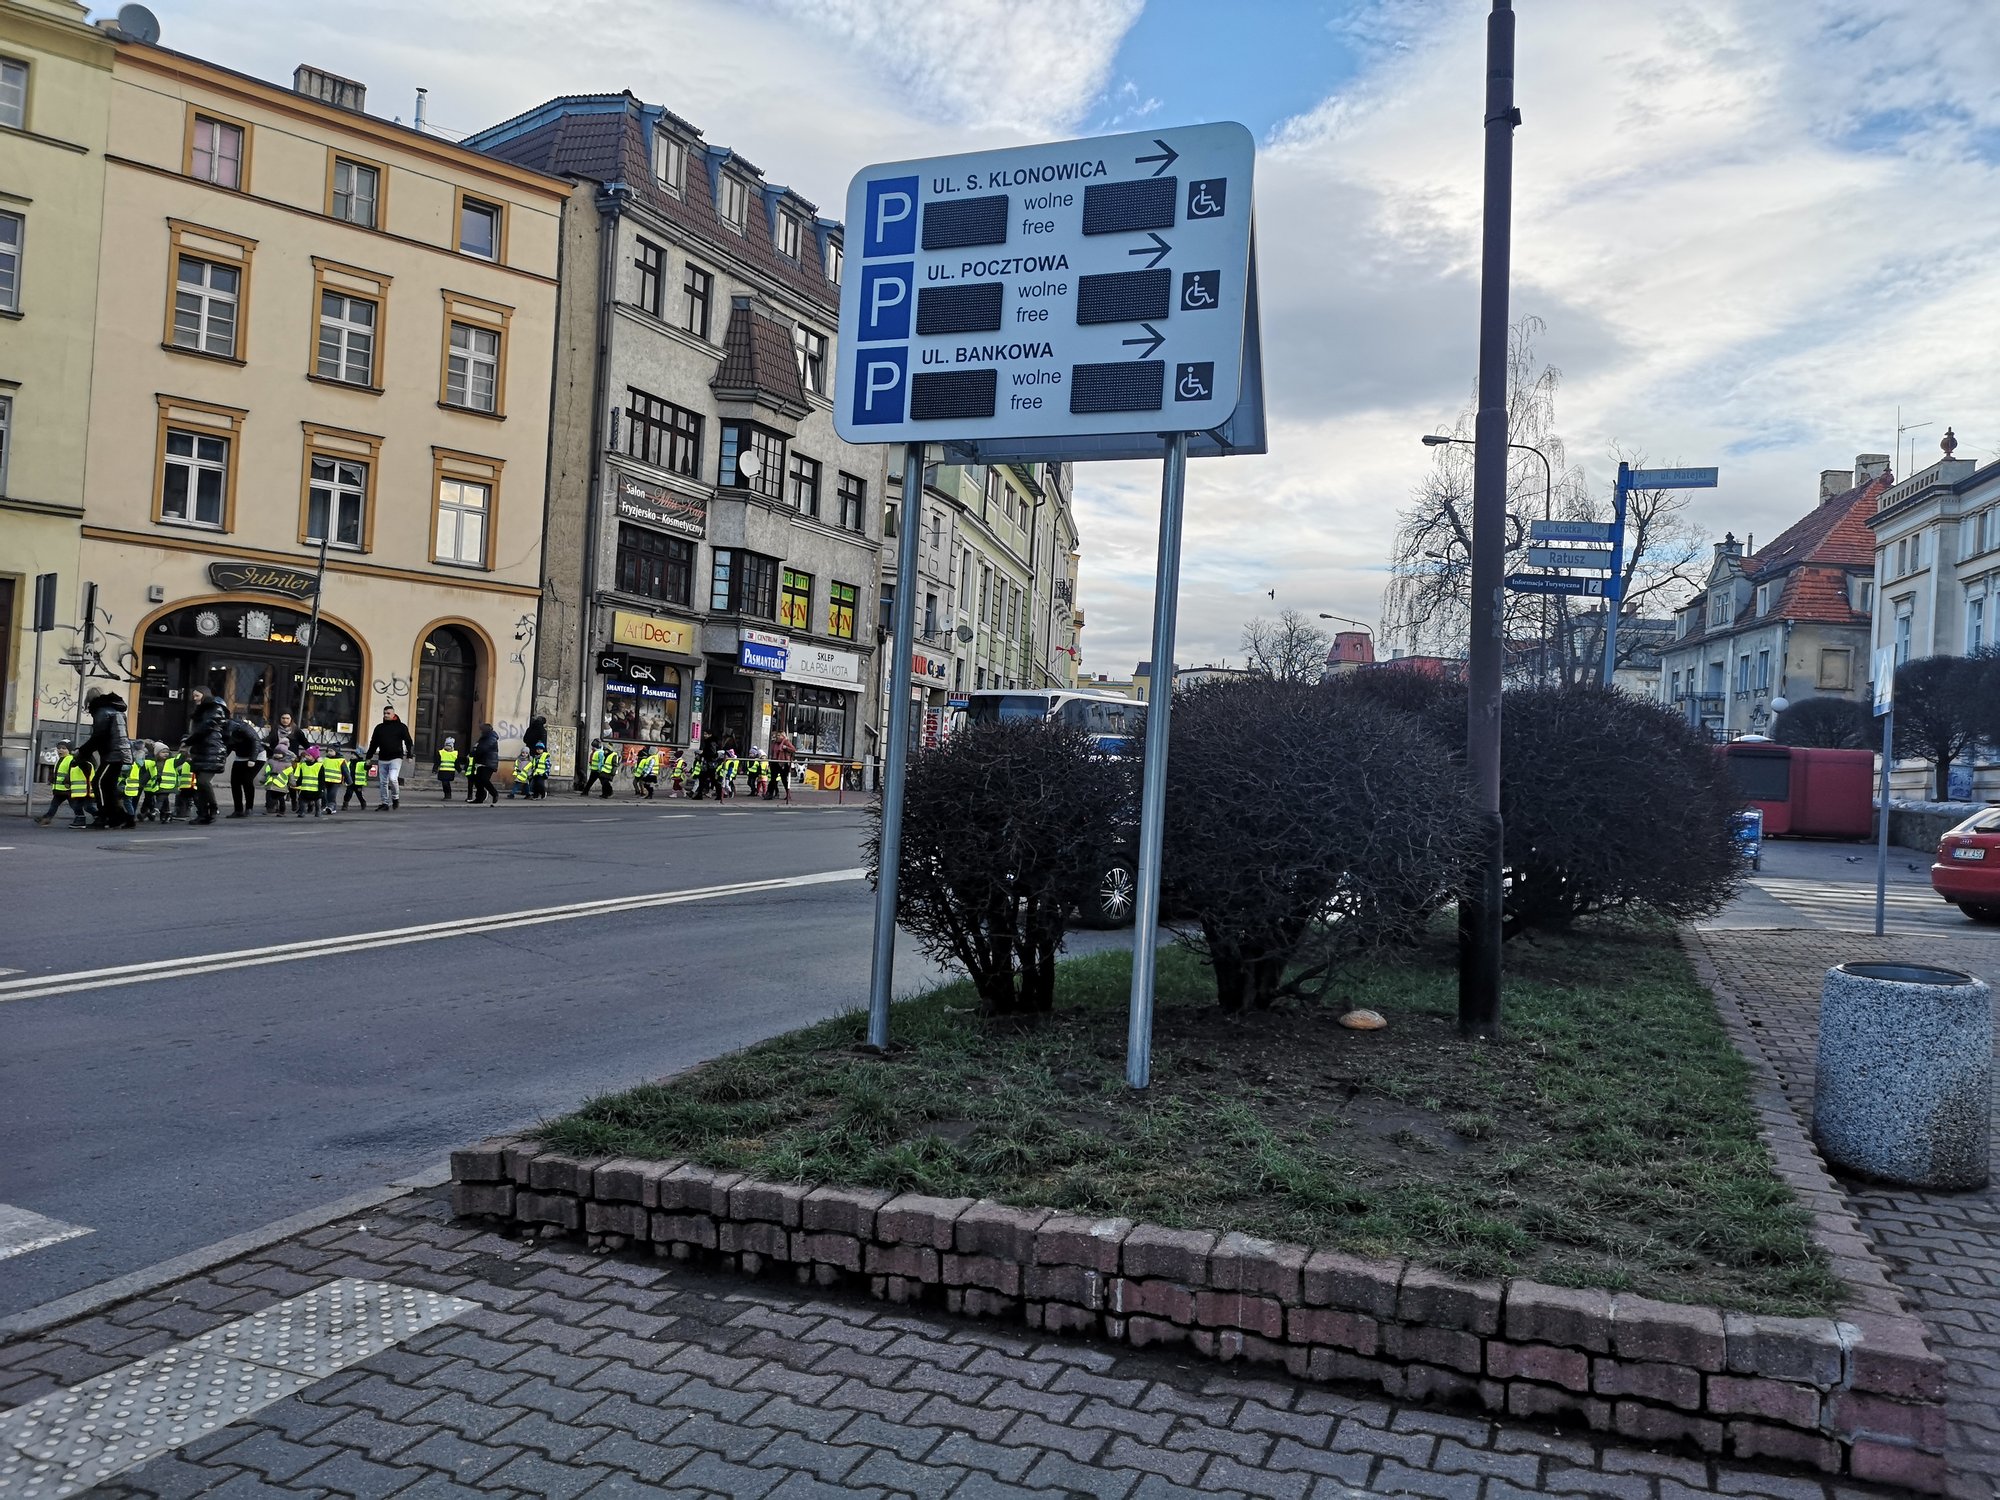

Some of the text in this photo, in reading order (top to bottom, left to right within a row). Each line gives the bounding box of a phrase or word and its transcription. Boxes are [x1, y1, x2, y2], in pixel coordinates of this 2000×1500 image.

[932, 160, 1108, 195] UL. S. KLONOWICA
[1024, 192, 1074, 211] wolne
[876, 191, 912, 244] P
[1022, 218, 1055, 236] free
[927, 254, 1070, 281] UL. POCZTOWA
[1018, 280, 1068, 298] wolne
[871, 276, 907, 328] P
[1016, 305, 1049, 323] free
[921, 341, 1054, 366] UL. BANKOWA
[865, 360, 901, 412] P
[1012, 369, 1062, 387] wolne
[1010, 394, 1043, 411] free
[1660, 470, 1706, 481] ul. Matejki
[626, 484, 646, 499] Salon
[622, 501, 657, 520] Fryzjersko
[661, 513, 704, 536] Kosmetyczny
[1542, 524, 1553, 533] ul.
[1549, 551, 1586, 565] Ratusz
[218, 566, 315, 591] Jubiler
[1512, 578, 1544, 587] Informacja
[1544, 580, 1580, 589] Turystyczna
[781, 600, 806, 622] KCN
[829, 611, 852, 632] KCN
[817, 651, 835, 663] SKLEP
[801, 659, 815, 672] DLA
[815, 662, 829, 674] PSA
[831, 665, 848, 677] KOTA
[306, 683, 343, 693] jubilerska
